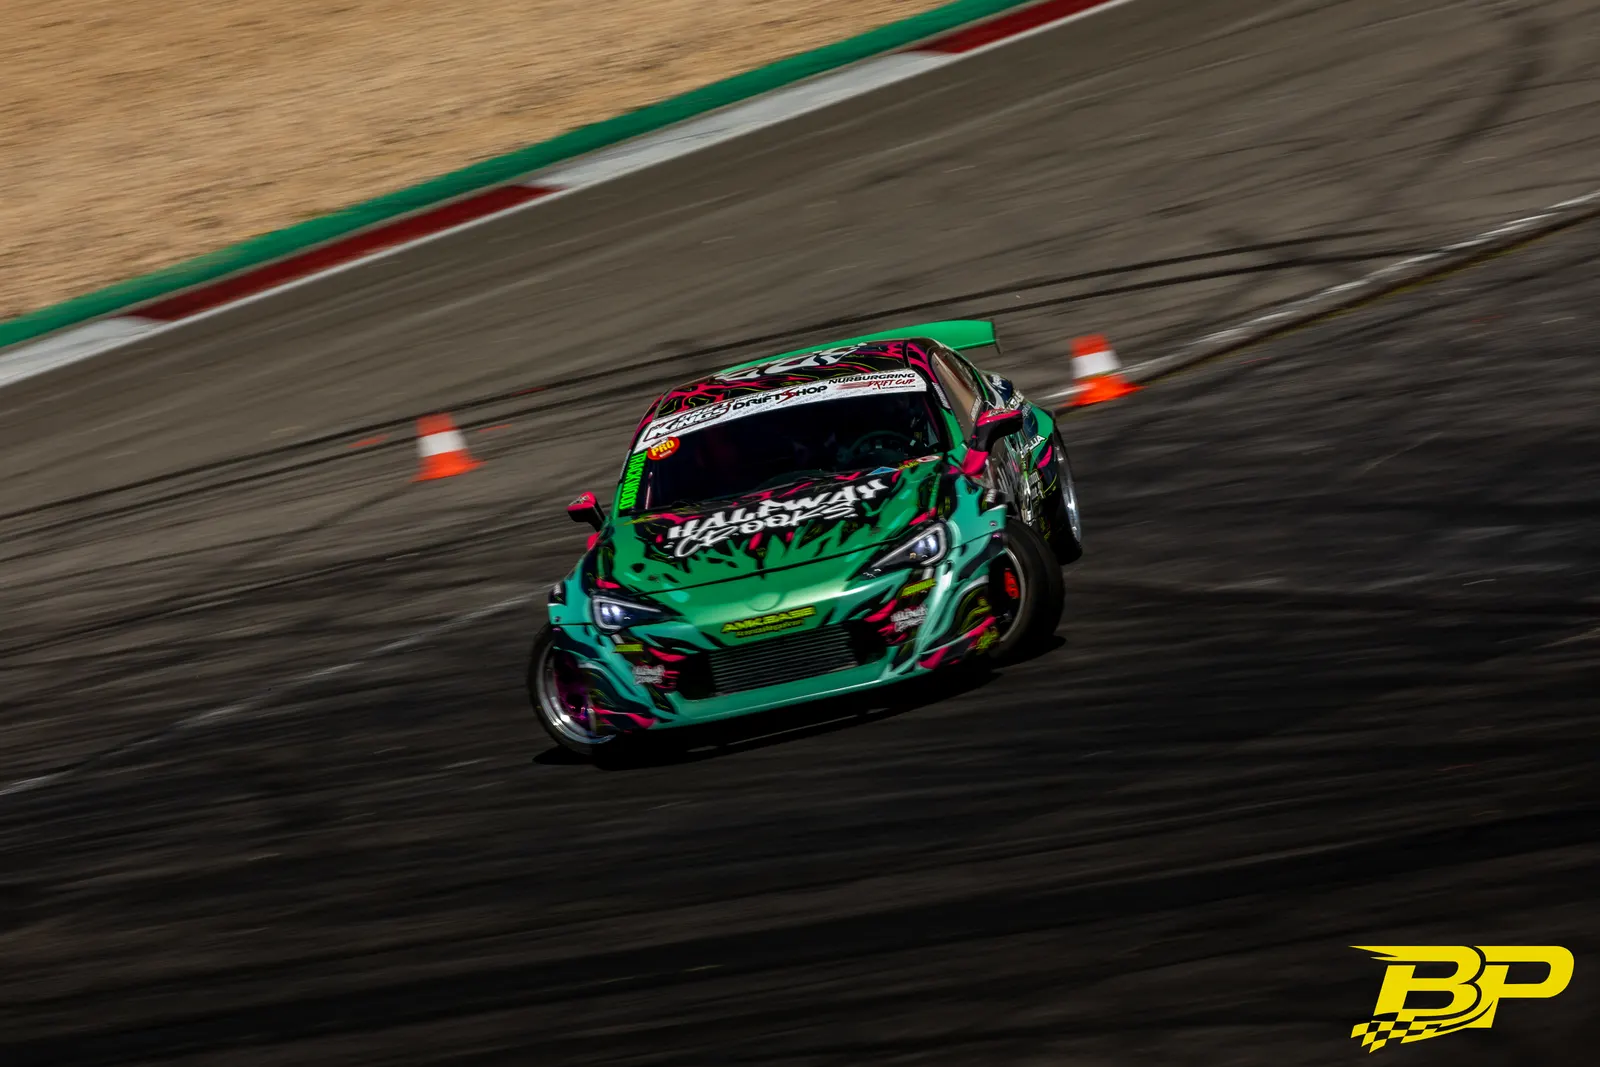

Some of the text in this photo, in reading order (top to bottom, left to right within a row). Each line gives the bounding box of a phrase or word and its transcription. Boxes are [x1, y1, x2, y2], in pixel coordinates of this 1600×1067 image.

[650, 440, 675, 457] PRO
[618, 450, 649, 510] TRACKWOOD
[667, 478, 889, 539] HALFWAY
